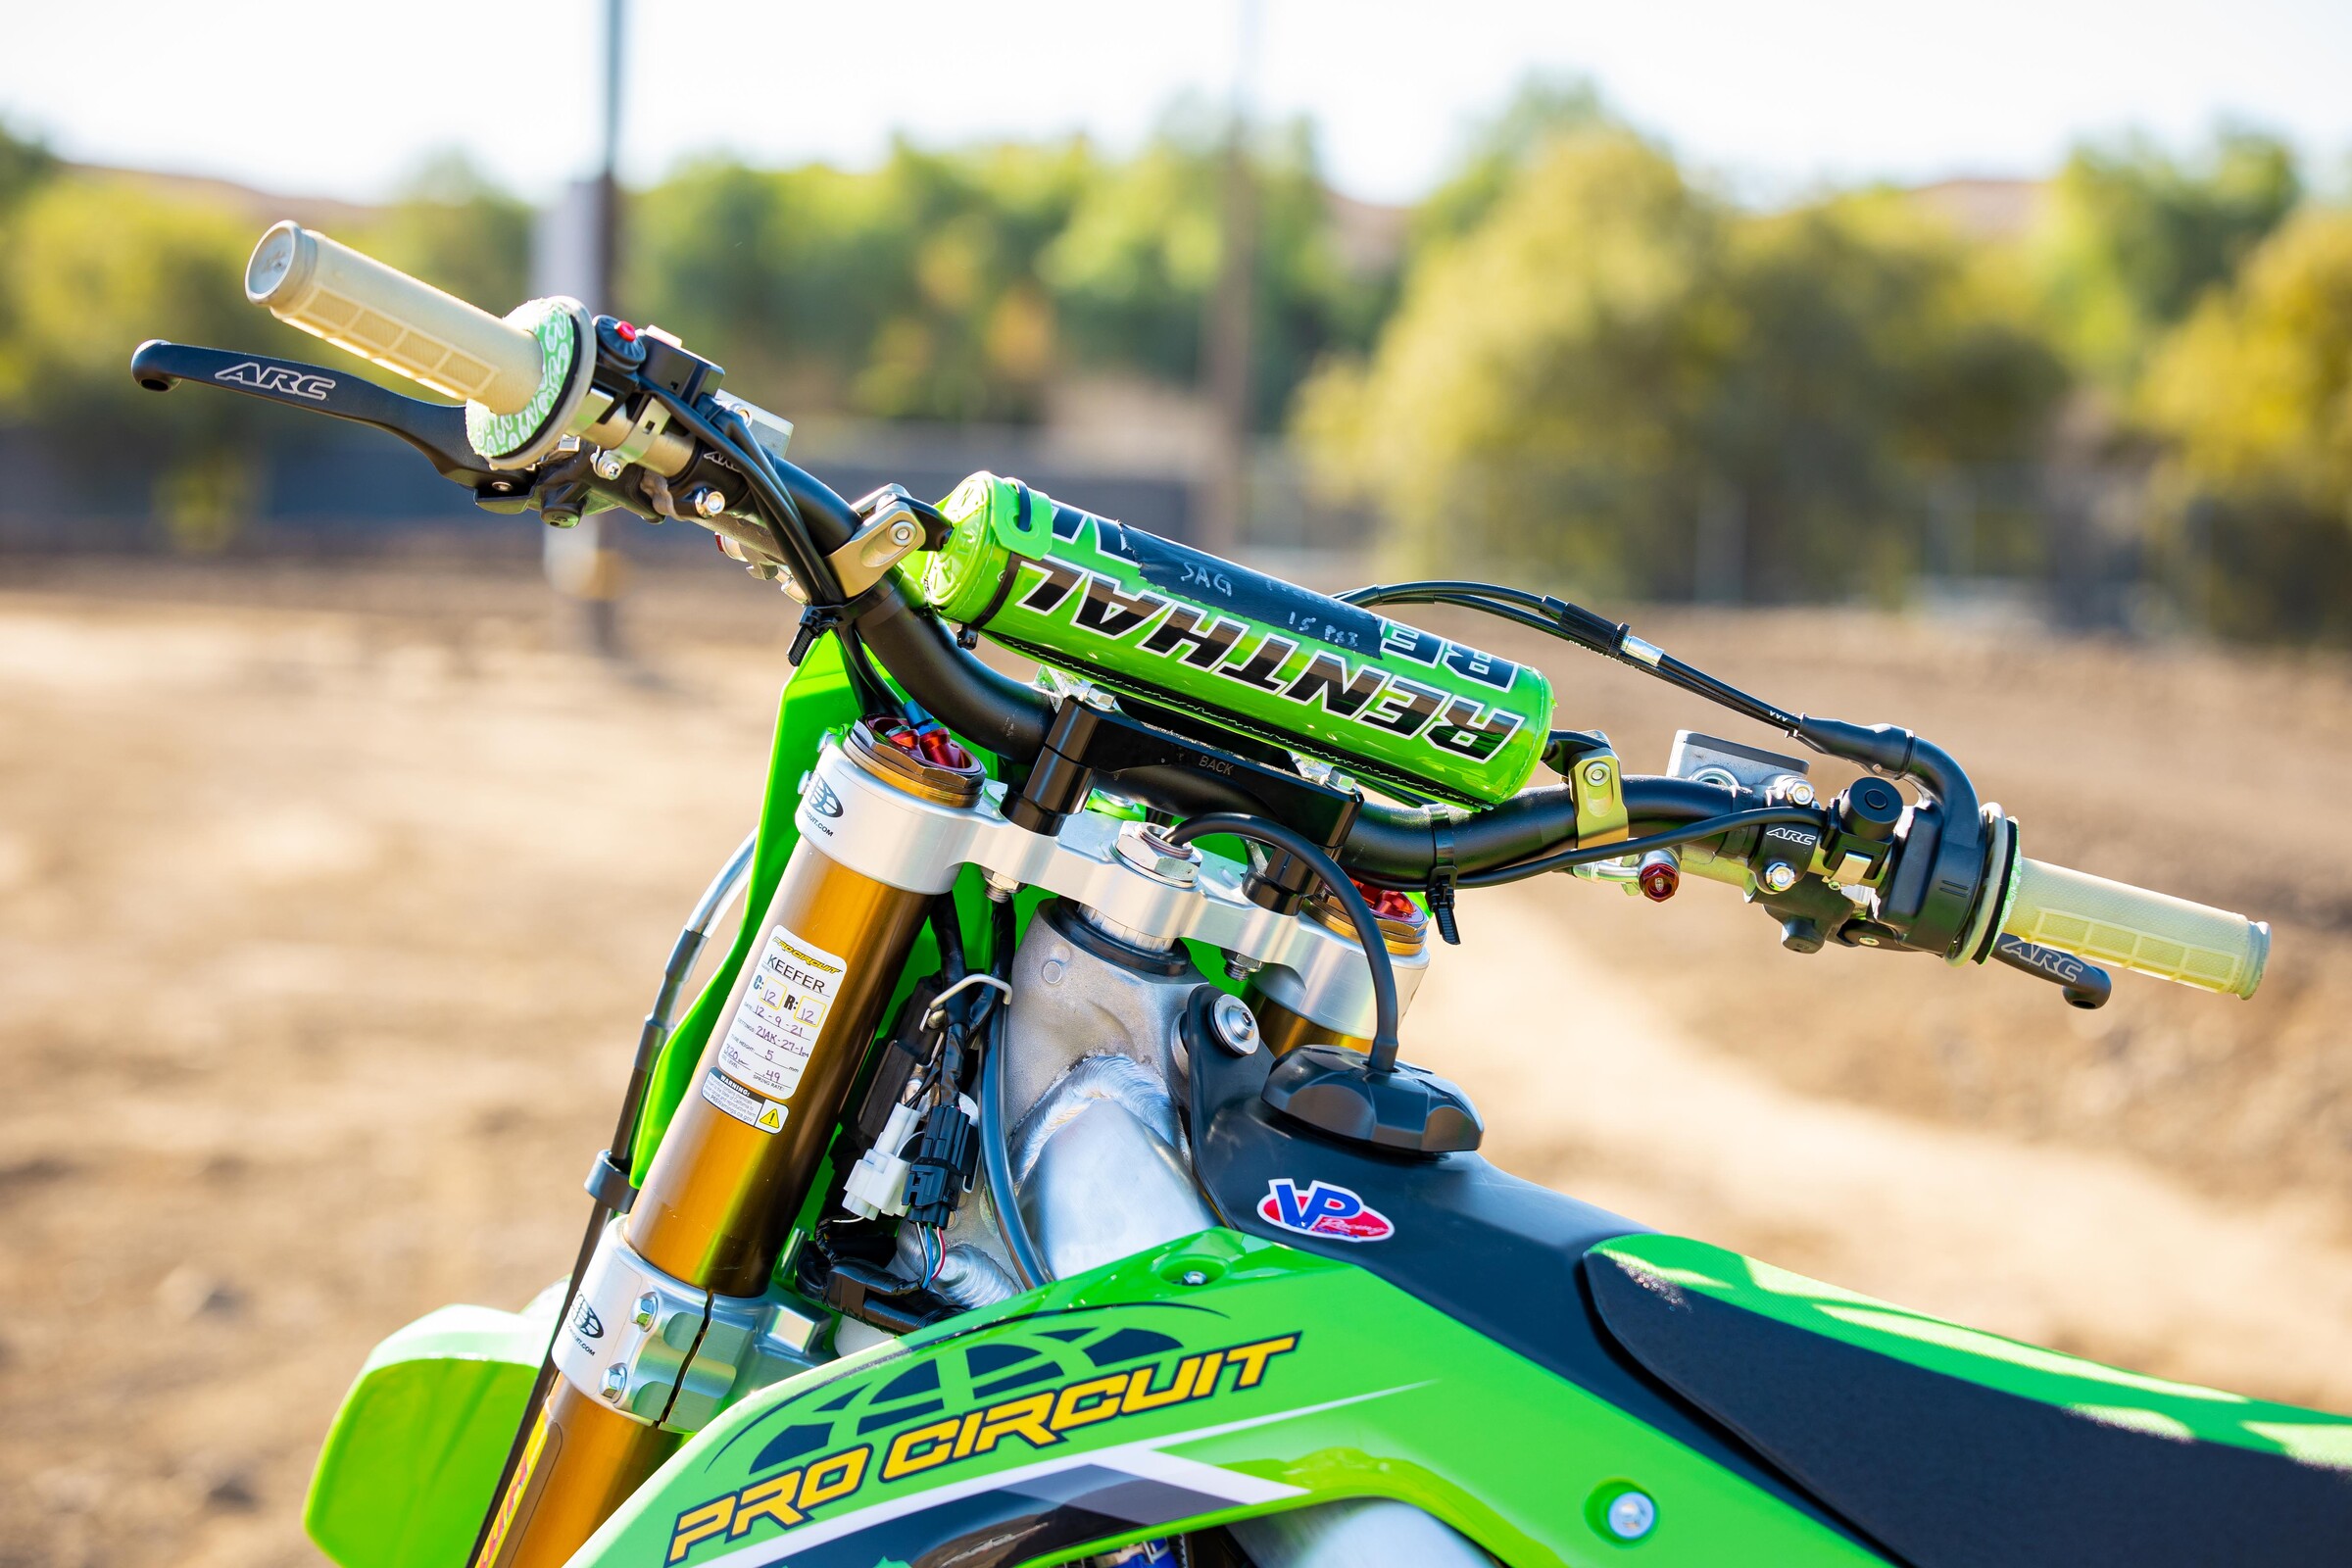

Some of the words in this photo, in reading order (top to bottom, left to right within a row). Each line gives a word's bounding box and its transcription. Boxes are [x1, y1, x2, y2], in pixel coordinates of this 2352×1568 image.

[215, 362, 336, 401] ARC
[1180, 562, 1233, 597] SAG
[1015, 555, 1526, 764] RENTHAL
[1199, 755, 1234, 775] BACK
[1766, 827, 1817, 846] ARC
[767, 954, 825, 994] KEEFER
[792, 950, 843, 974] CIRCUIT
[2001, 941, 2083, 983] ARC
[754, 975, 764, 990] C:
[763, 989, 776, 1005] 12
[784, 994, 799, 1010] R:
[801, 1007, 814, 1024] 12
[764, 1049, 774, 1061] 5
[720, 1075, 751, 1097] WARNING:
[753, 1074, 770, 1086] SPRING
[1273, 1181, 1363, 1232] VP
[666, 1445, 871, 1566] PRO
[882, 1331, 1302, 1481] CIRCUIT
